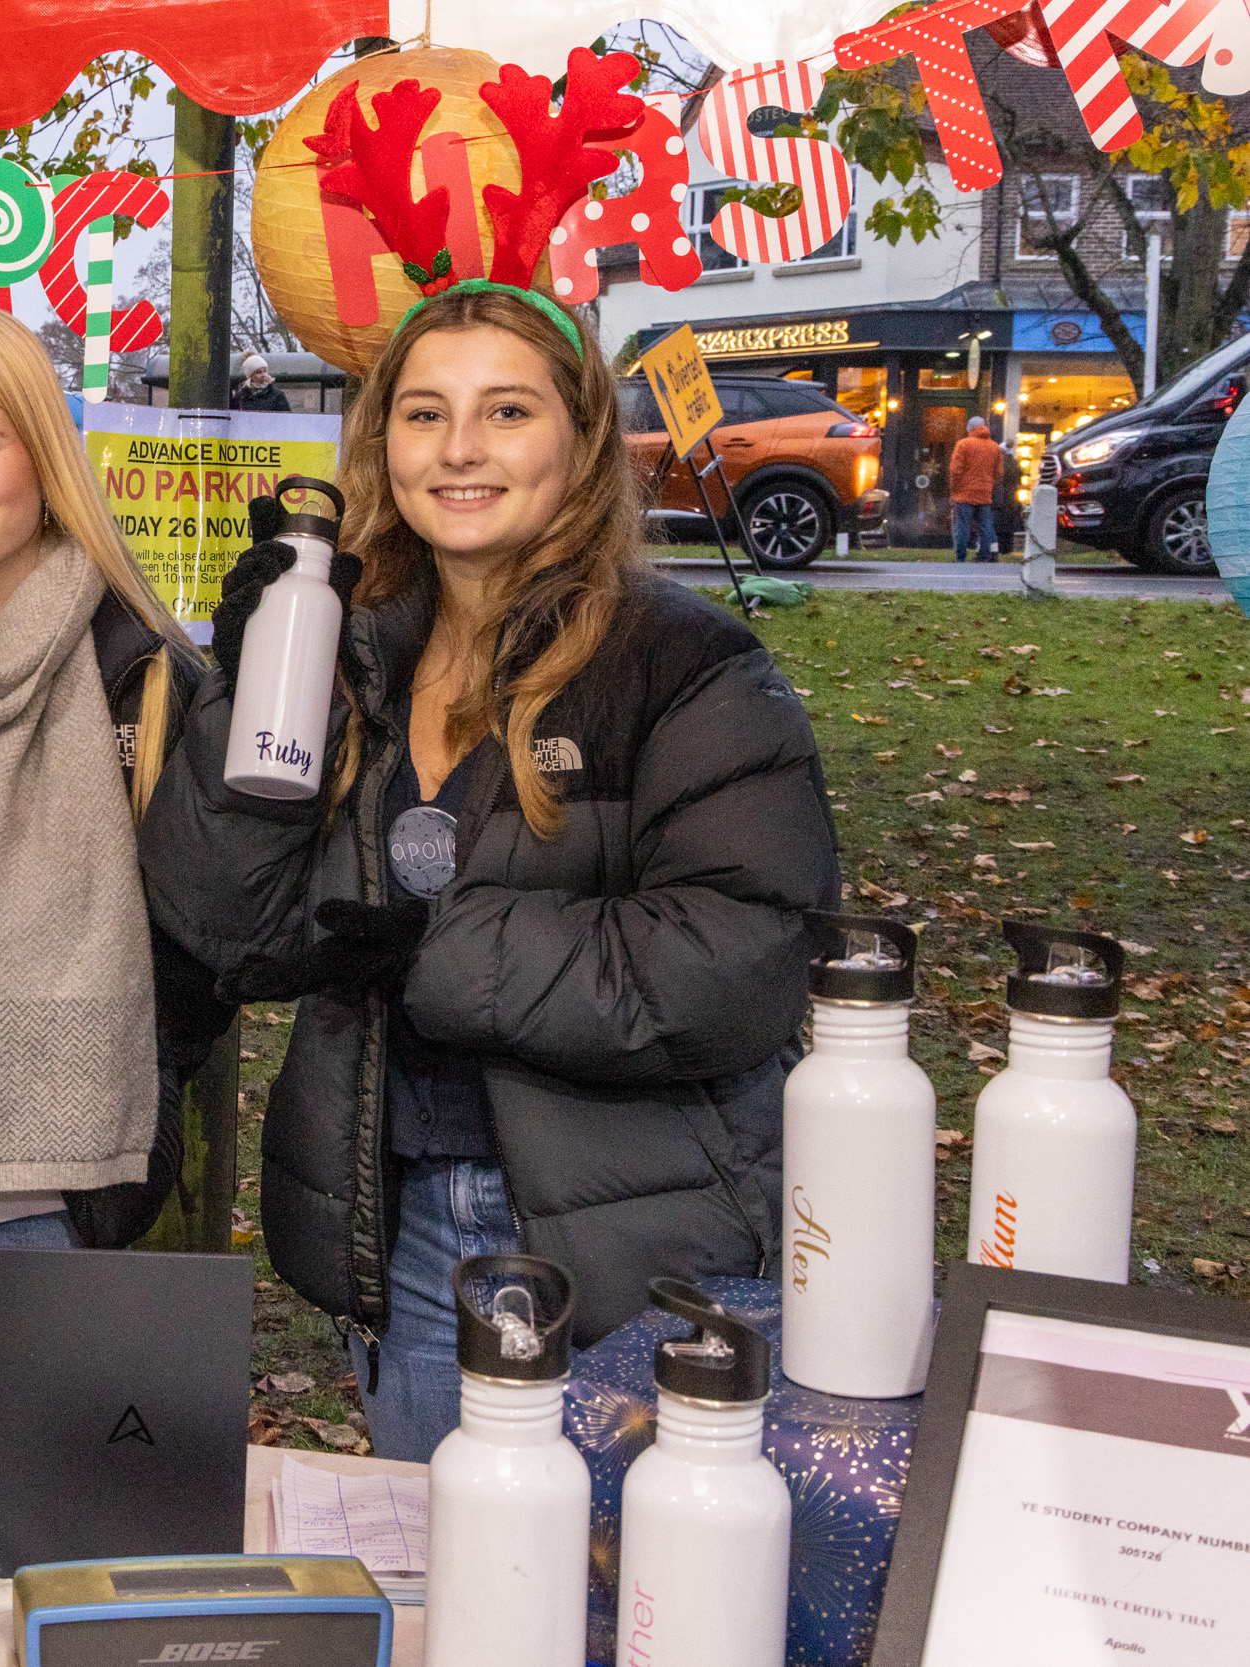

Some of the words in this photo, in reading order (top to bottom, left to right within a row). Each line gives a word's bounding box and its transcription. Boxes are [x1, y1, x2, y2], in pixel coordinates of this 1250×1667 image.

[128, 440, 213, 462] ADVANCE
[219, 444, 281, 463] NOTICE
[105, 466, 146, 501] NO
[155, 470, 308, 505] PARKING
[113, 515, 163, 537] NDAY
[168, 517, 197, 538] 26
[206, 517, 253, 539] NOV
[136, 549, 150, 560] will
[153, 550, 164, 561] be
[168, 550, 207, 561] closed
[210, 551, 225, 561] and
[163, 562, 180, 573] the
[184, 562, 216, 573] hours
[219, 562, 227, 573] of
[164, 573, 196, 587] 10pm
[256, 731, 313, 777] Ruby
[534, 738, 558, 751] THE
[792, 1185, 831, 1294] Alex
[1021, 1501, 1039, 1513] YE
[1043, 1506, 1113, 1527] STUDENT
[1117, 1519, 1193, 1543] COMPANY
[1118, 1545, 1162, 1562] 305126
[1052, 1587, 1109, 1608] HEREBY
[1113, 1600, 1174, 1621] CERTIFY
[1179, 1612, 1217, 1629] THAT
[138, 1640, 281, 1663] BOSE
[1104, 1637, 1146, 1655] Apollo
